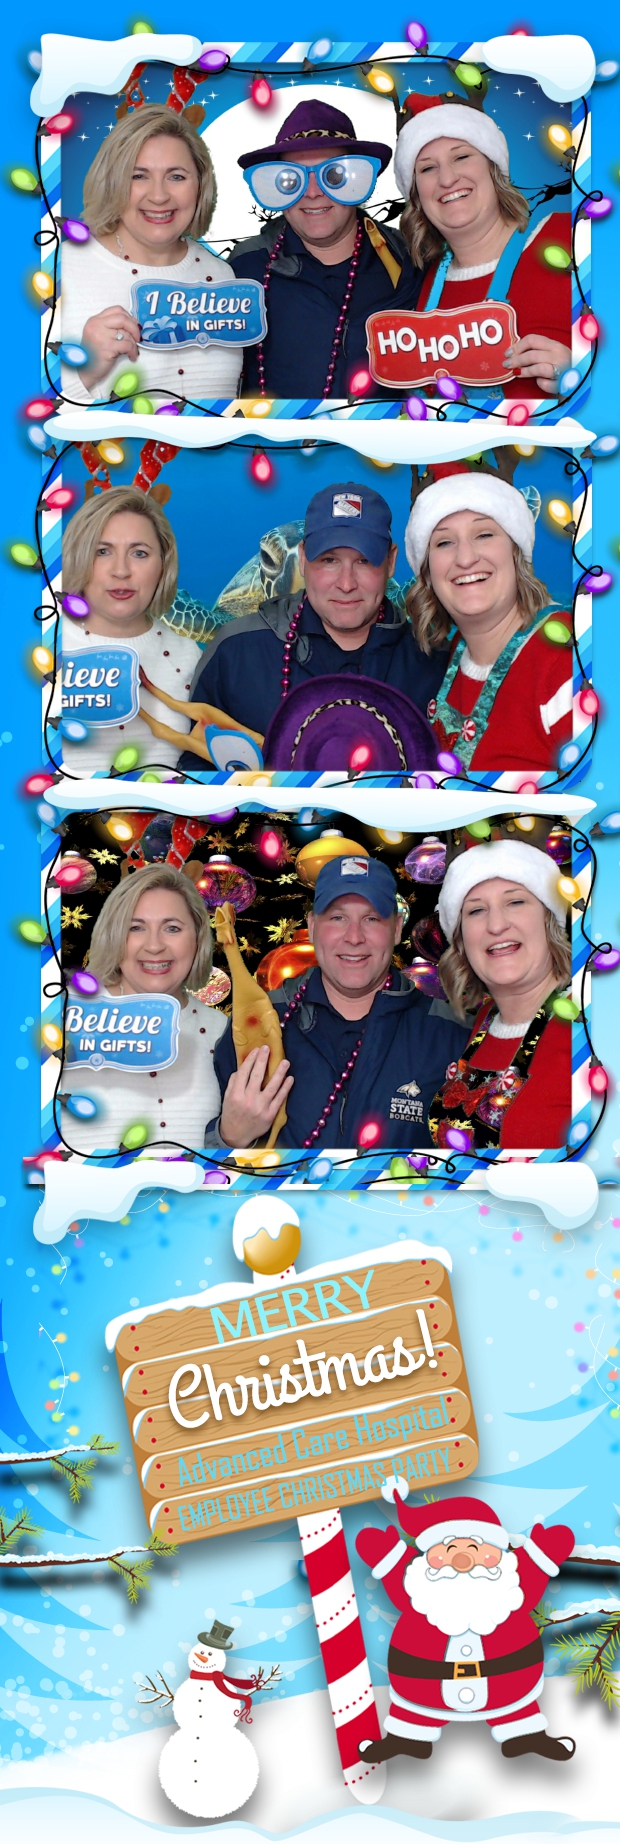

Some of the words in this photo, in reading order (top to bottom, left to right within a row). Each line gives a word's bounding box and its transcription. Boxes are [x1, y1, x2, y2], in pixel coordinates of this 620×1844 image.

[146, 290, 160, 315] I
[167, 290, 251, 315] Believe
[186, 319, 200, 331] IN
[203, 318, 246, 331] GIFTS!
[62, 661, 120, 688] ieve
[62, 1005, 162, 1035] Believe
[79, 1038, 95, 1051] IN
[100, 1039, 152, 1053] GIFTS!
[390, 1097, 424, 1107] MONTANA
[390, 1103, 423, 1116] STATE
